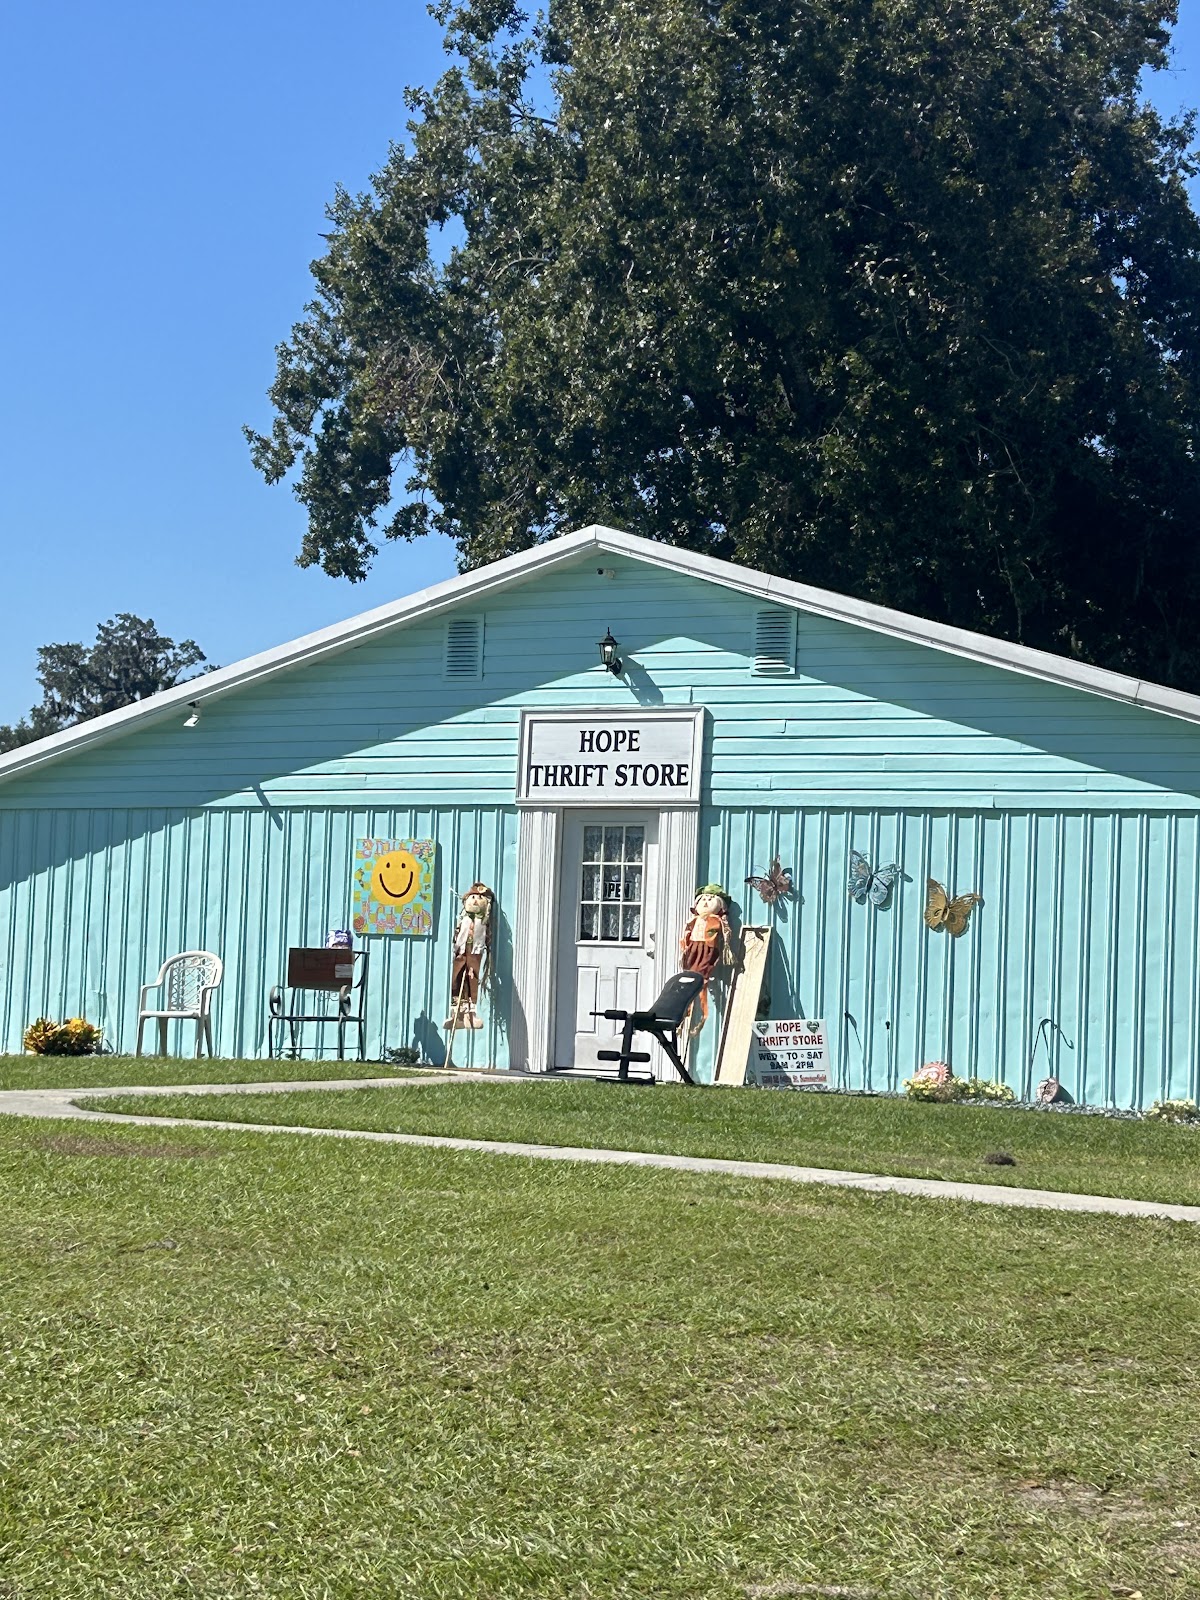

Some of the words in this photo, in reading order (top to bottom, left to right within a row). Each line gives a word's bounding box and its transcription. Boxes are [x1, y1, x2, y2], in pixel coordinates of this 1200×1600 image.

[578, 729, 641, 753] HOPE
[530, 764, 609, 787] THRIFT
[614, 763, 689, 787] STORE
[775, 1022, 801, 1033] HOPE
[757, 1037, 790, 1046] THRIFT
[792, 1035, 823, 1045] STORE
[758, 1052, 778, 1061] WED
[787, 1052, 798, 1060] TO
[806, 1051, 823, 1060] SAT
[795, 1060, 814, 1069] 2PM
